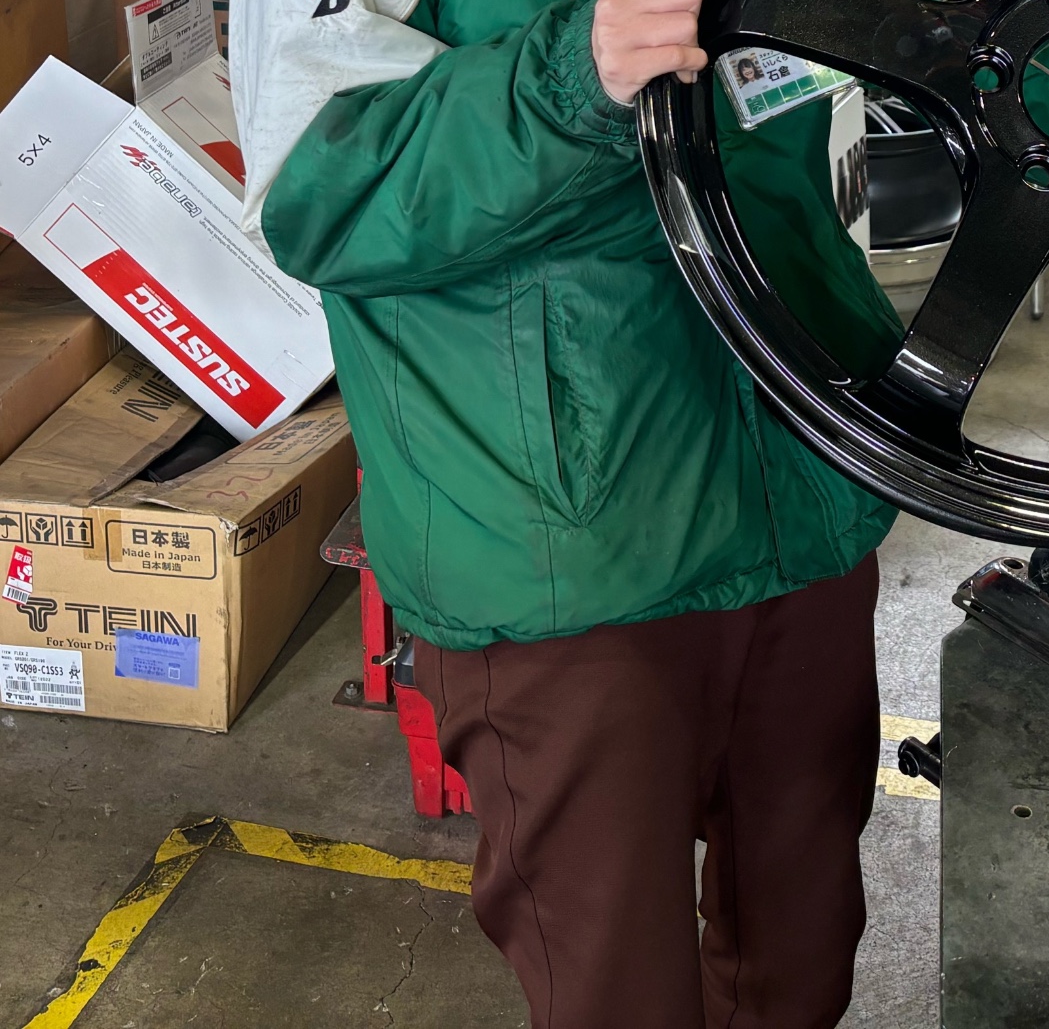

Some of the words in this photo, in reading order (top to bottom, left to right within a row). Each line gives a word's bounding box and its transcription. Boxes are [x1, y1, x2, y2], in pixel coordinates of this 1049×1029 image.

[762, 54, 789, 69] いしくら
[766, 65, 791, 82] 石倉
[132, 118, 151, 137] JAPAN
[149, 135, 158, 143] IN
[156, 141, 174, 158] MADE
[140, 159, 203, 218] tanabe
[124, 284, 251, 397] SUSTEC
[132, 528, 191, 550] 日本製
[122, 547, 151, 560] Made
[154, 550, 165, 560] in
[168, 550, 201, 564] Japan
[142, 560, 182, 572] 日本制造
[65, 602, 200, 641] TEIN
[46, 636, 64, 648] For
[67, 638, 92, 651] Your
[135, 631, 180, 647] SAGAWA
[14, 662, 64, 676] VSQ90-C1SS3
[13, 693, 35, 702] TEIN
